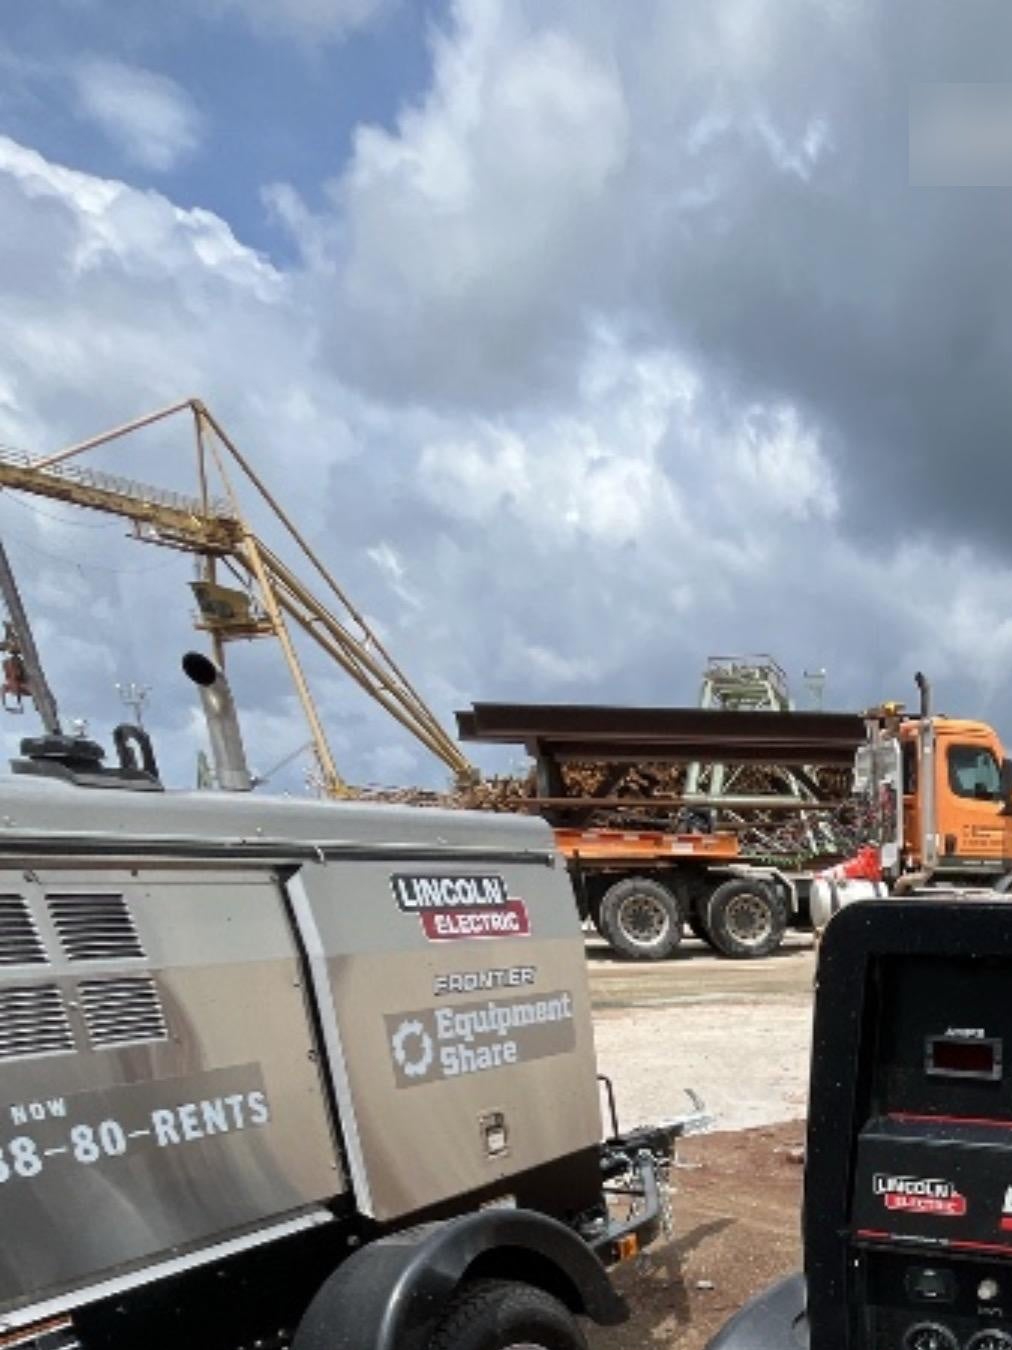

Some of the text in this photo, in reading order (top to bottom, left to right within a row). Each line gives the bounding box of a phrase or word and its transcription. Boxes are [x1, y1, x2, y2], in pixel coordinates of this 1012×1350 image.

[398, 877, 505, 907] LINCOLN
[434, 911, 520, 934] ELECTRIC
[434, 992, 572, 1042] Equipment
[440, 1040, 518, 1076] Share
[9, 1097, 67, 1126] NOW
[877, 1177, 949, 1198] LINCOLN
